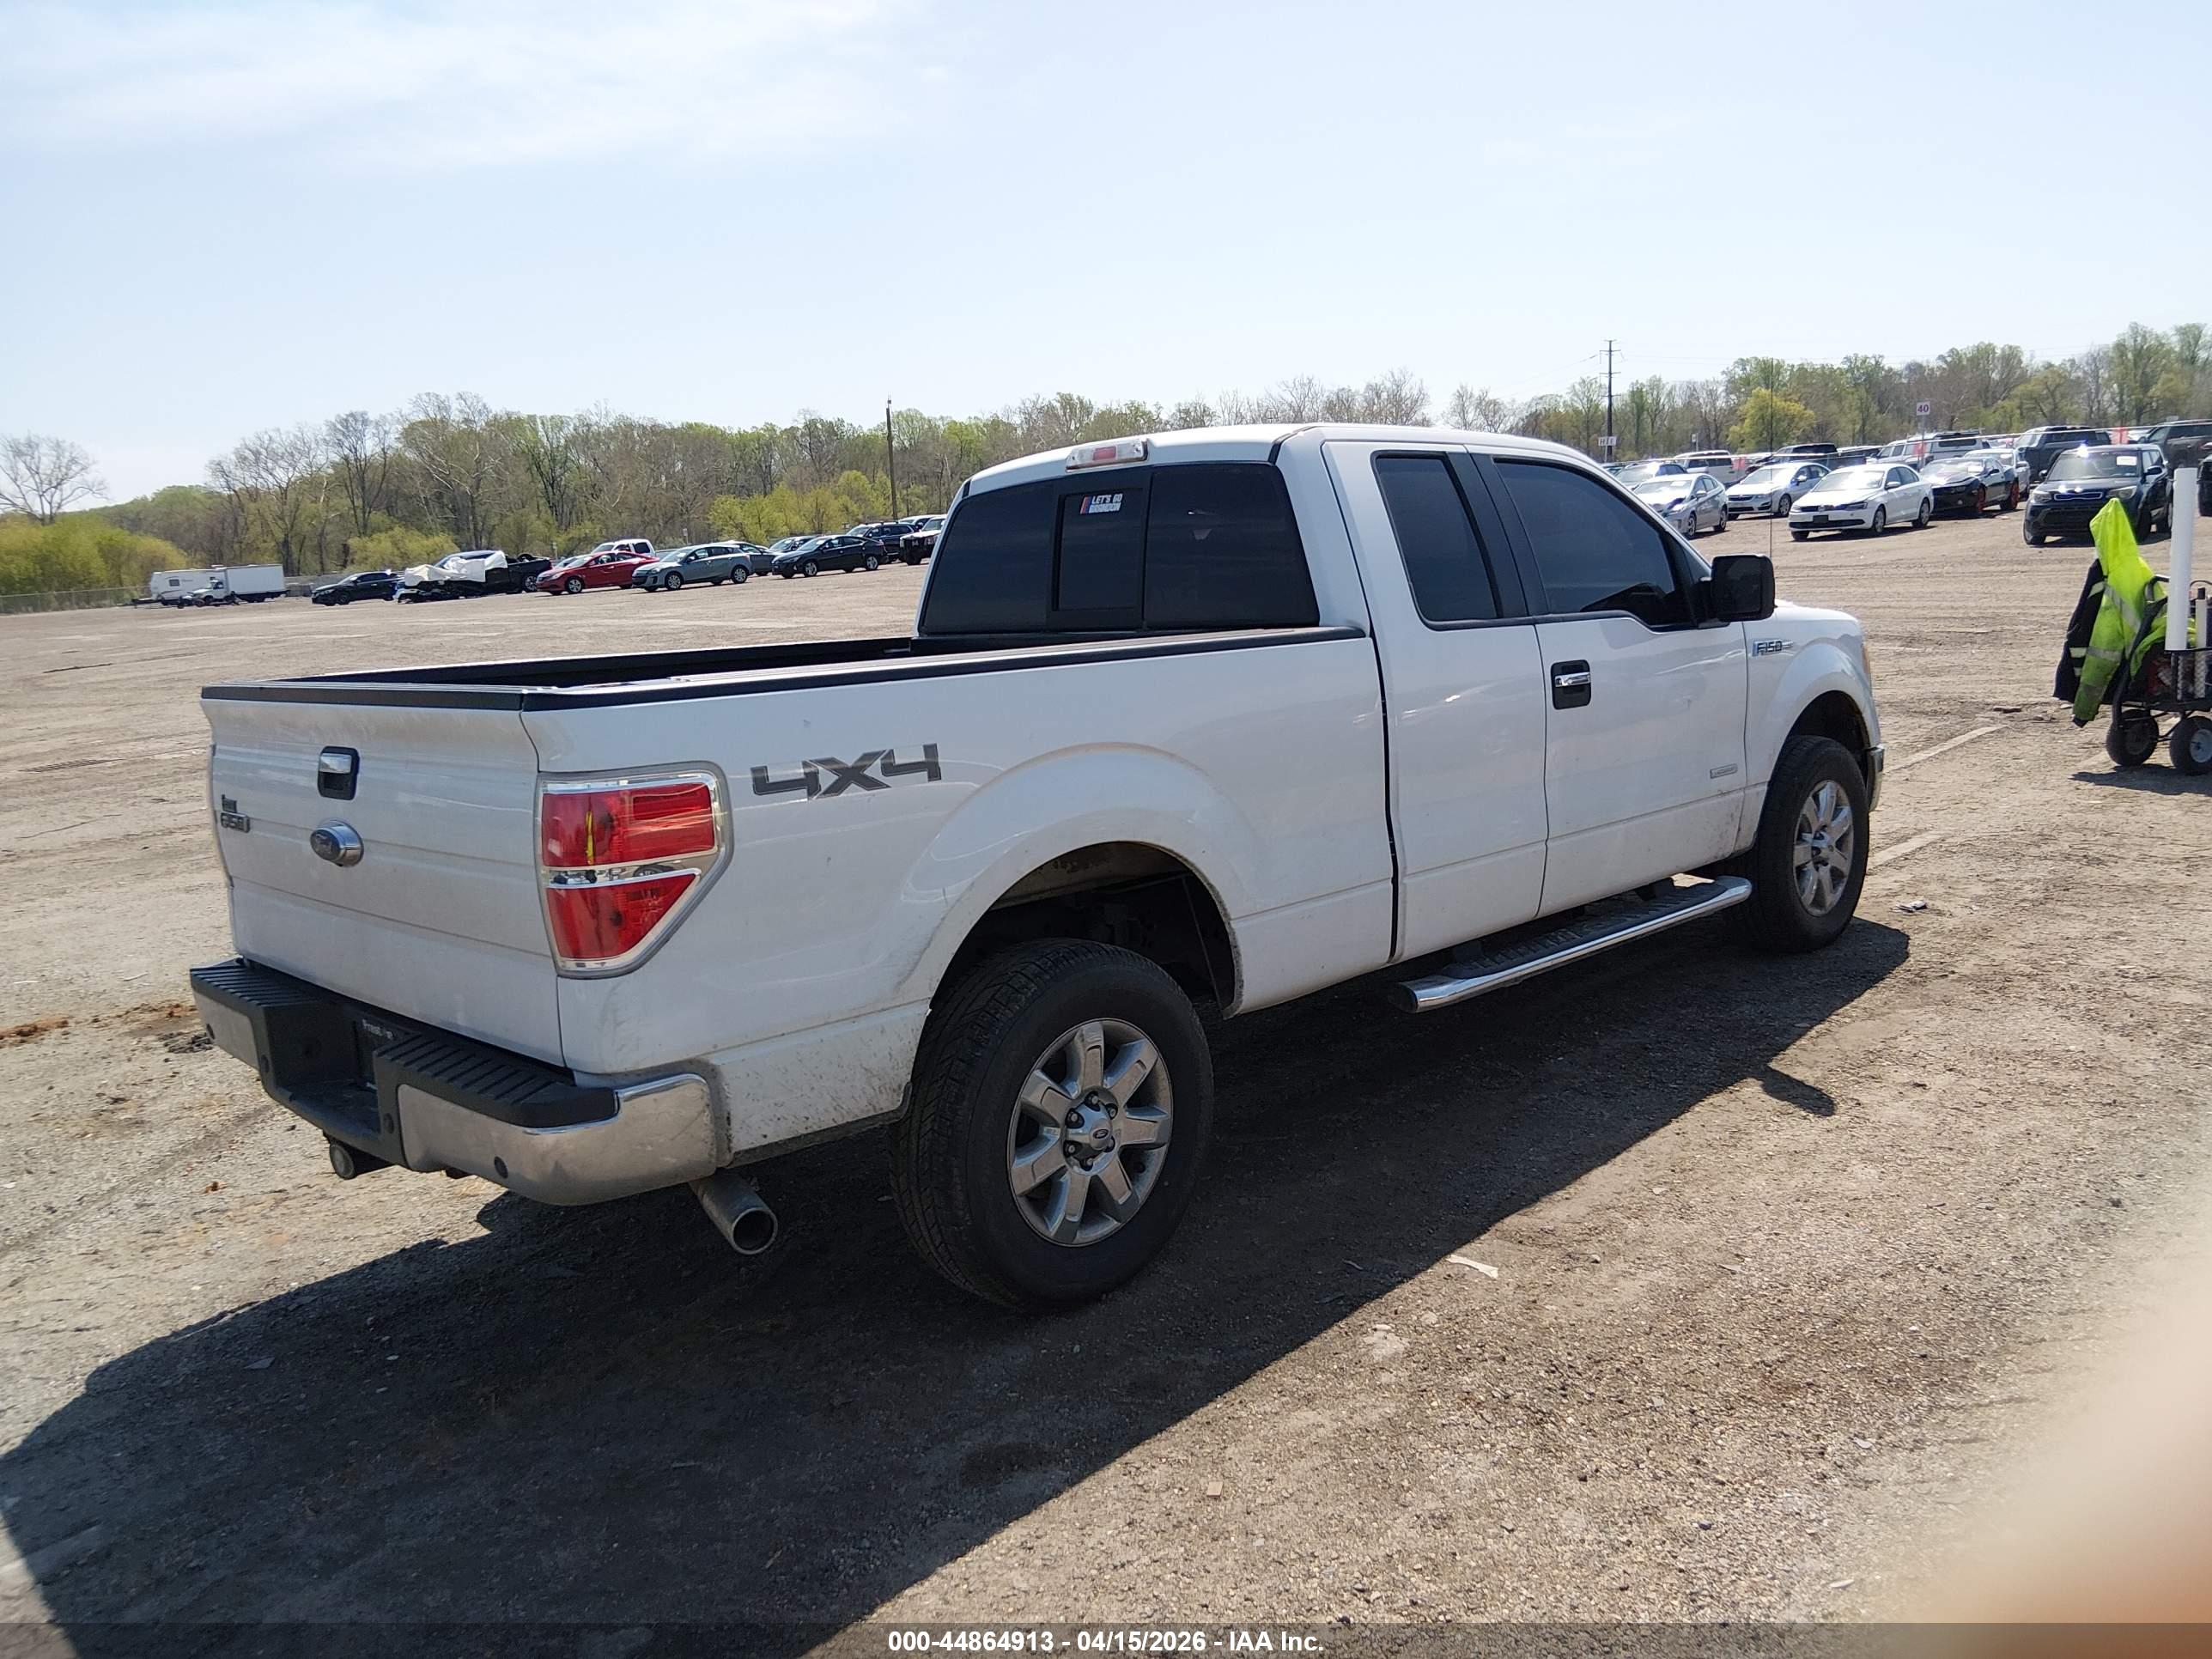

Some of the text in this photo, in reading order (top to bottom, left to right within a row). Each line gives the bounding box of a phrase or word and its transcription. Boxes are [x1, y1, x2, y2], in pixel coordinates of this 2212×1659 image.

[1917, 404, 1929, 413] 40
[1091, 494, 1123, 504] LET'S GO
